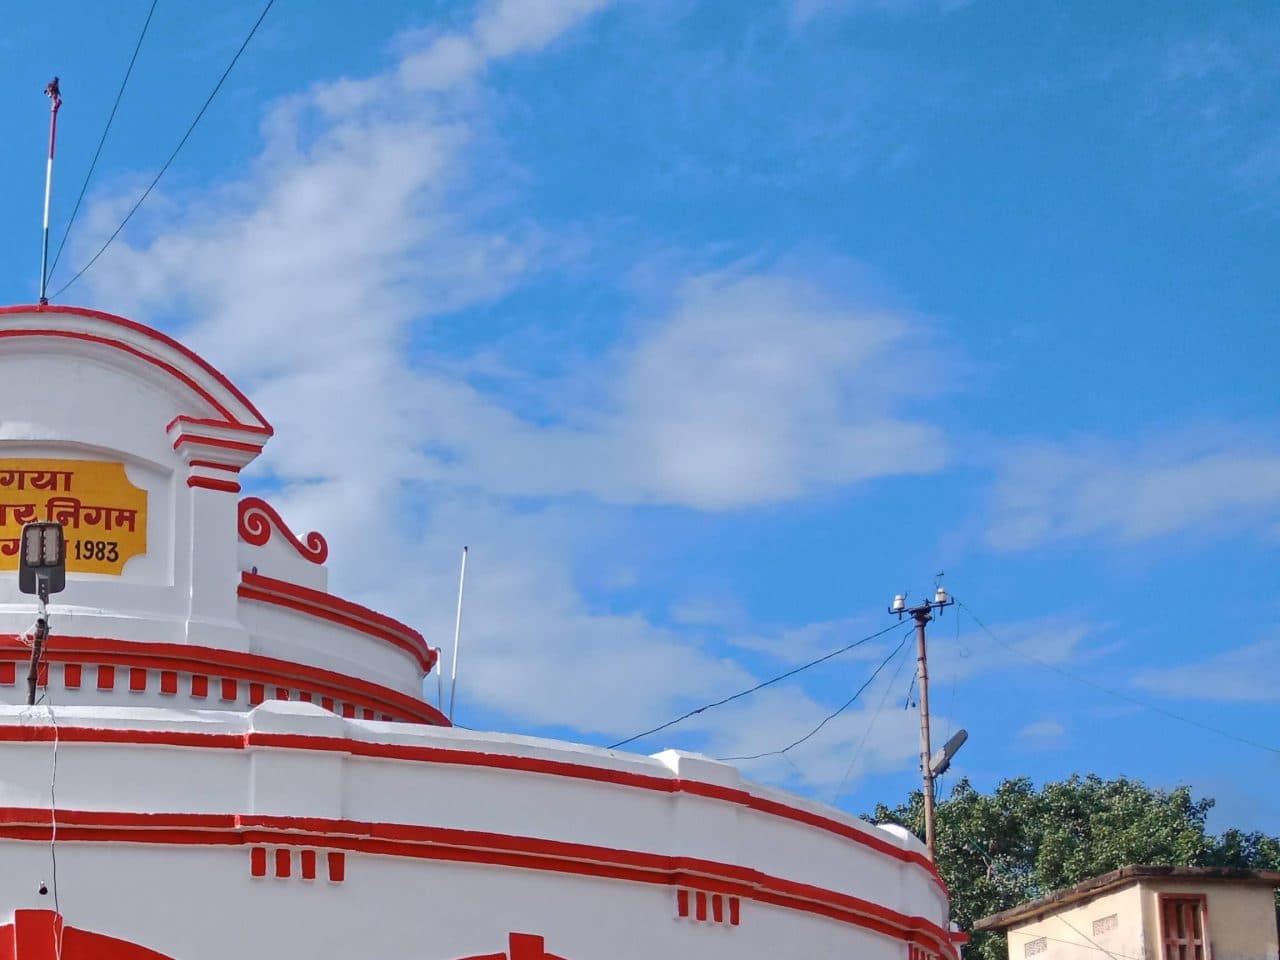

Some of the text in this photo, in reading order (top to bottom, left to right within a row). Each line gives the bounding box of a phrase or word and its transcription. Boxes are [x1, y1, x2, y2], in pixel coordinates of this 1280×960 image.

[0, 470, 74, 491] गया
[45, 497, 138, 532] निगम
[75, 540, 119, 563] 1983
